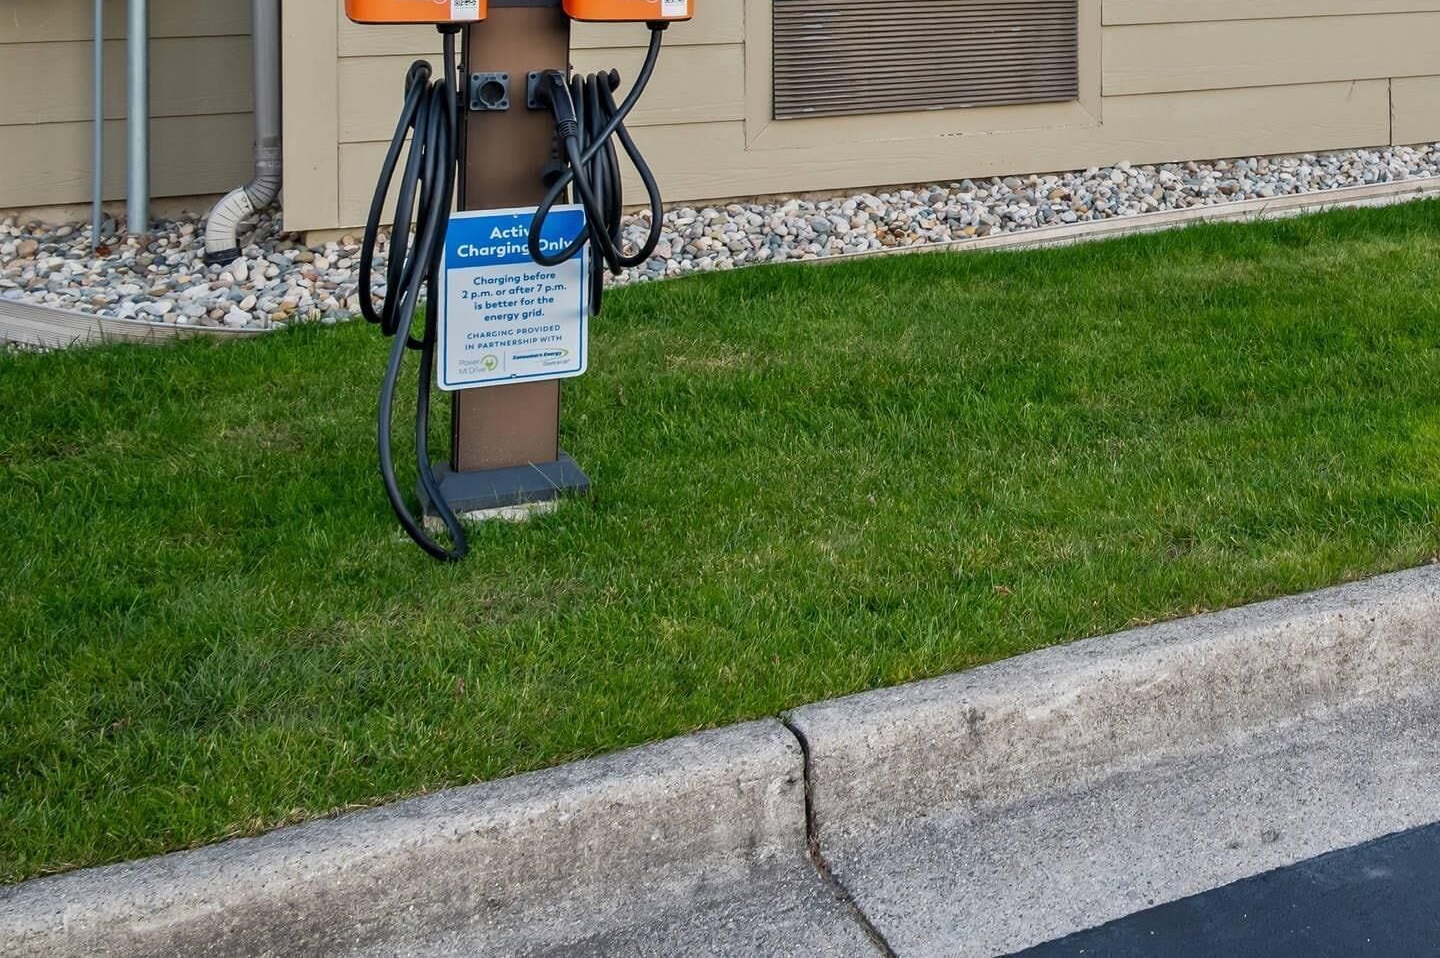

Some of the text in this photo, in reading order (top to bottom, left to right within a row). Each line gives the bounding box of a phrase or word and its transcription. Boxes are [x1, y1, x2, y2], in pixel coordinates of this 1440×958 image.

[489, 224, 531, 240] Activ
[457, 242, 531, 258] Charging
[473, 271, 556, 286] Charging before
[461, 283, 567, 300] 2 p.m. or after 7 p.m.
[474, 295, 555, 310] is better for the
[484, 308, 545, 322] energy grid.
[466, 324, 561, 340] CHARGING PROVIDED
[465, 334, 563, 351] IN PARTNERSHIP WITH
